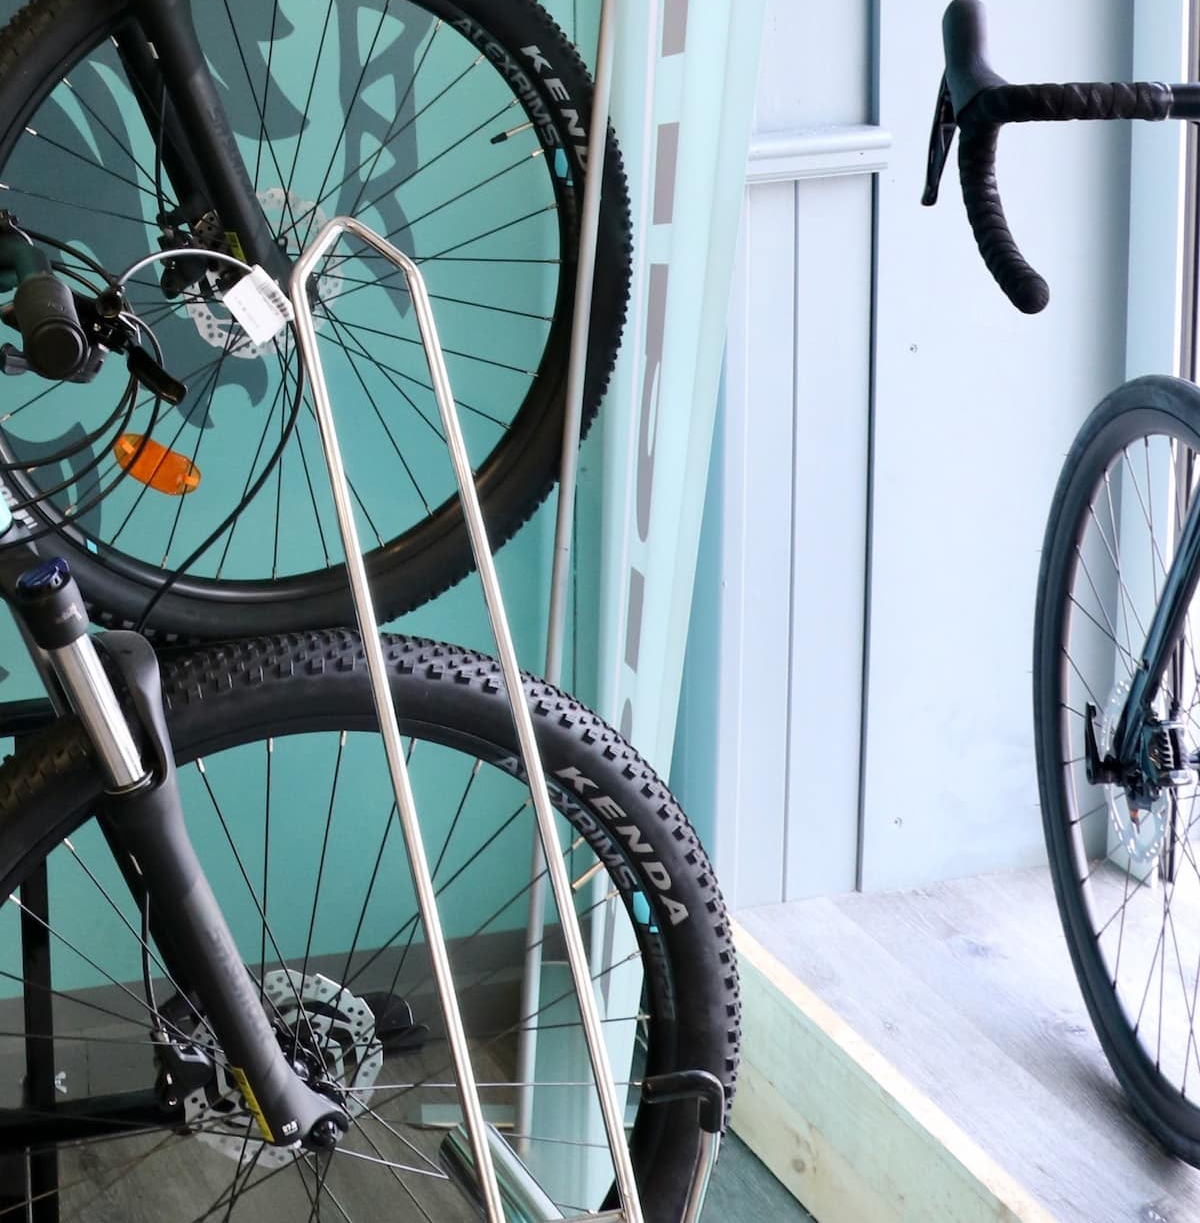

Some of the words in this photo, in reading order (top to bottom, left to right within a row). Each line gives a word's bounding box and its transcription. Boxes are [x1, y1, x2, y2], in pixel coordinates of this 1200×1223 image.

[519, 45, 588, 172] KEND
[497, 756, 638, 890] AEXRIMS
[554, 766, 689, 926] KENDA
